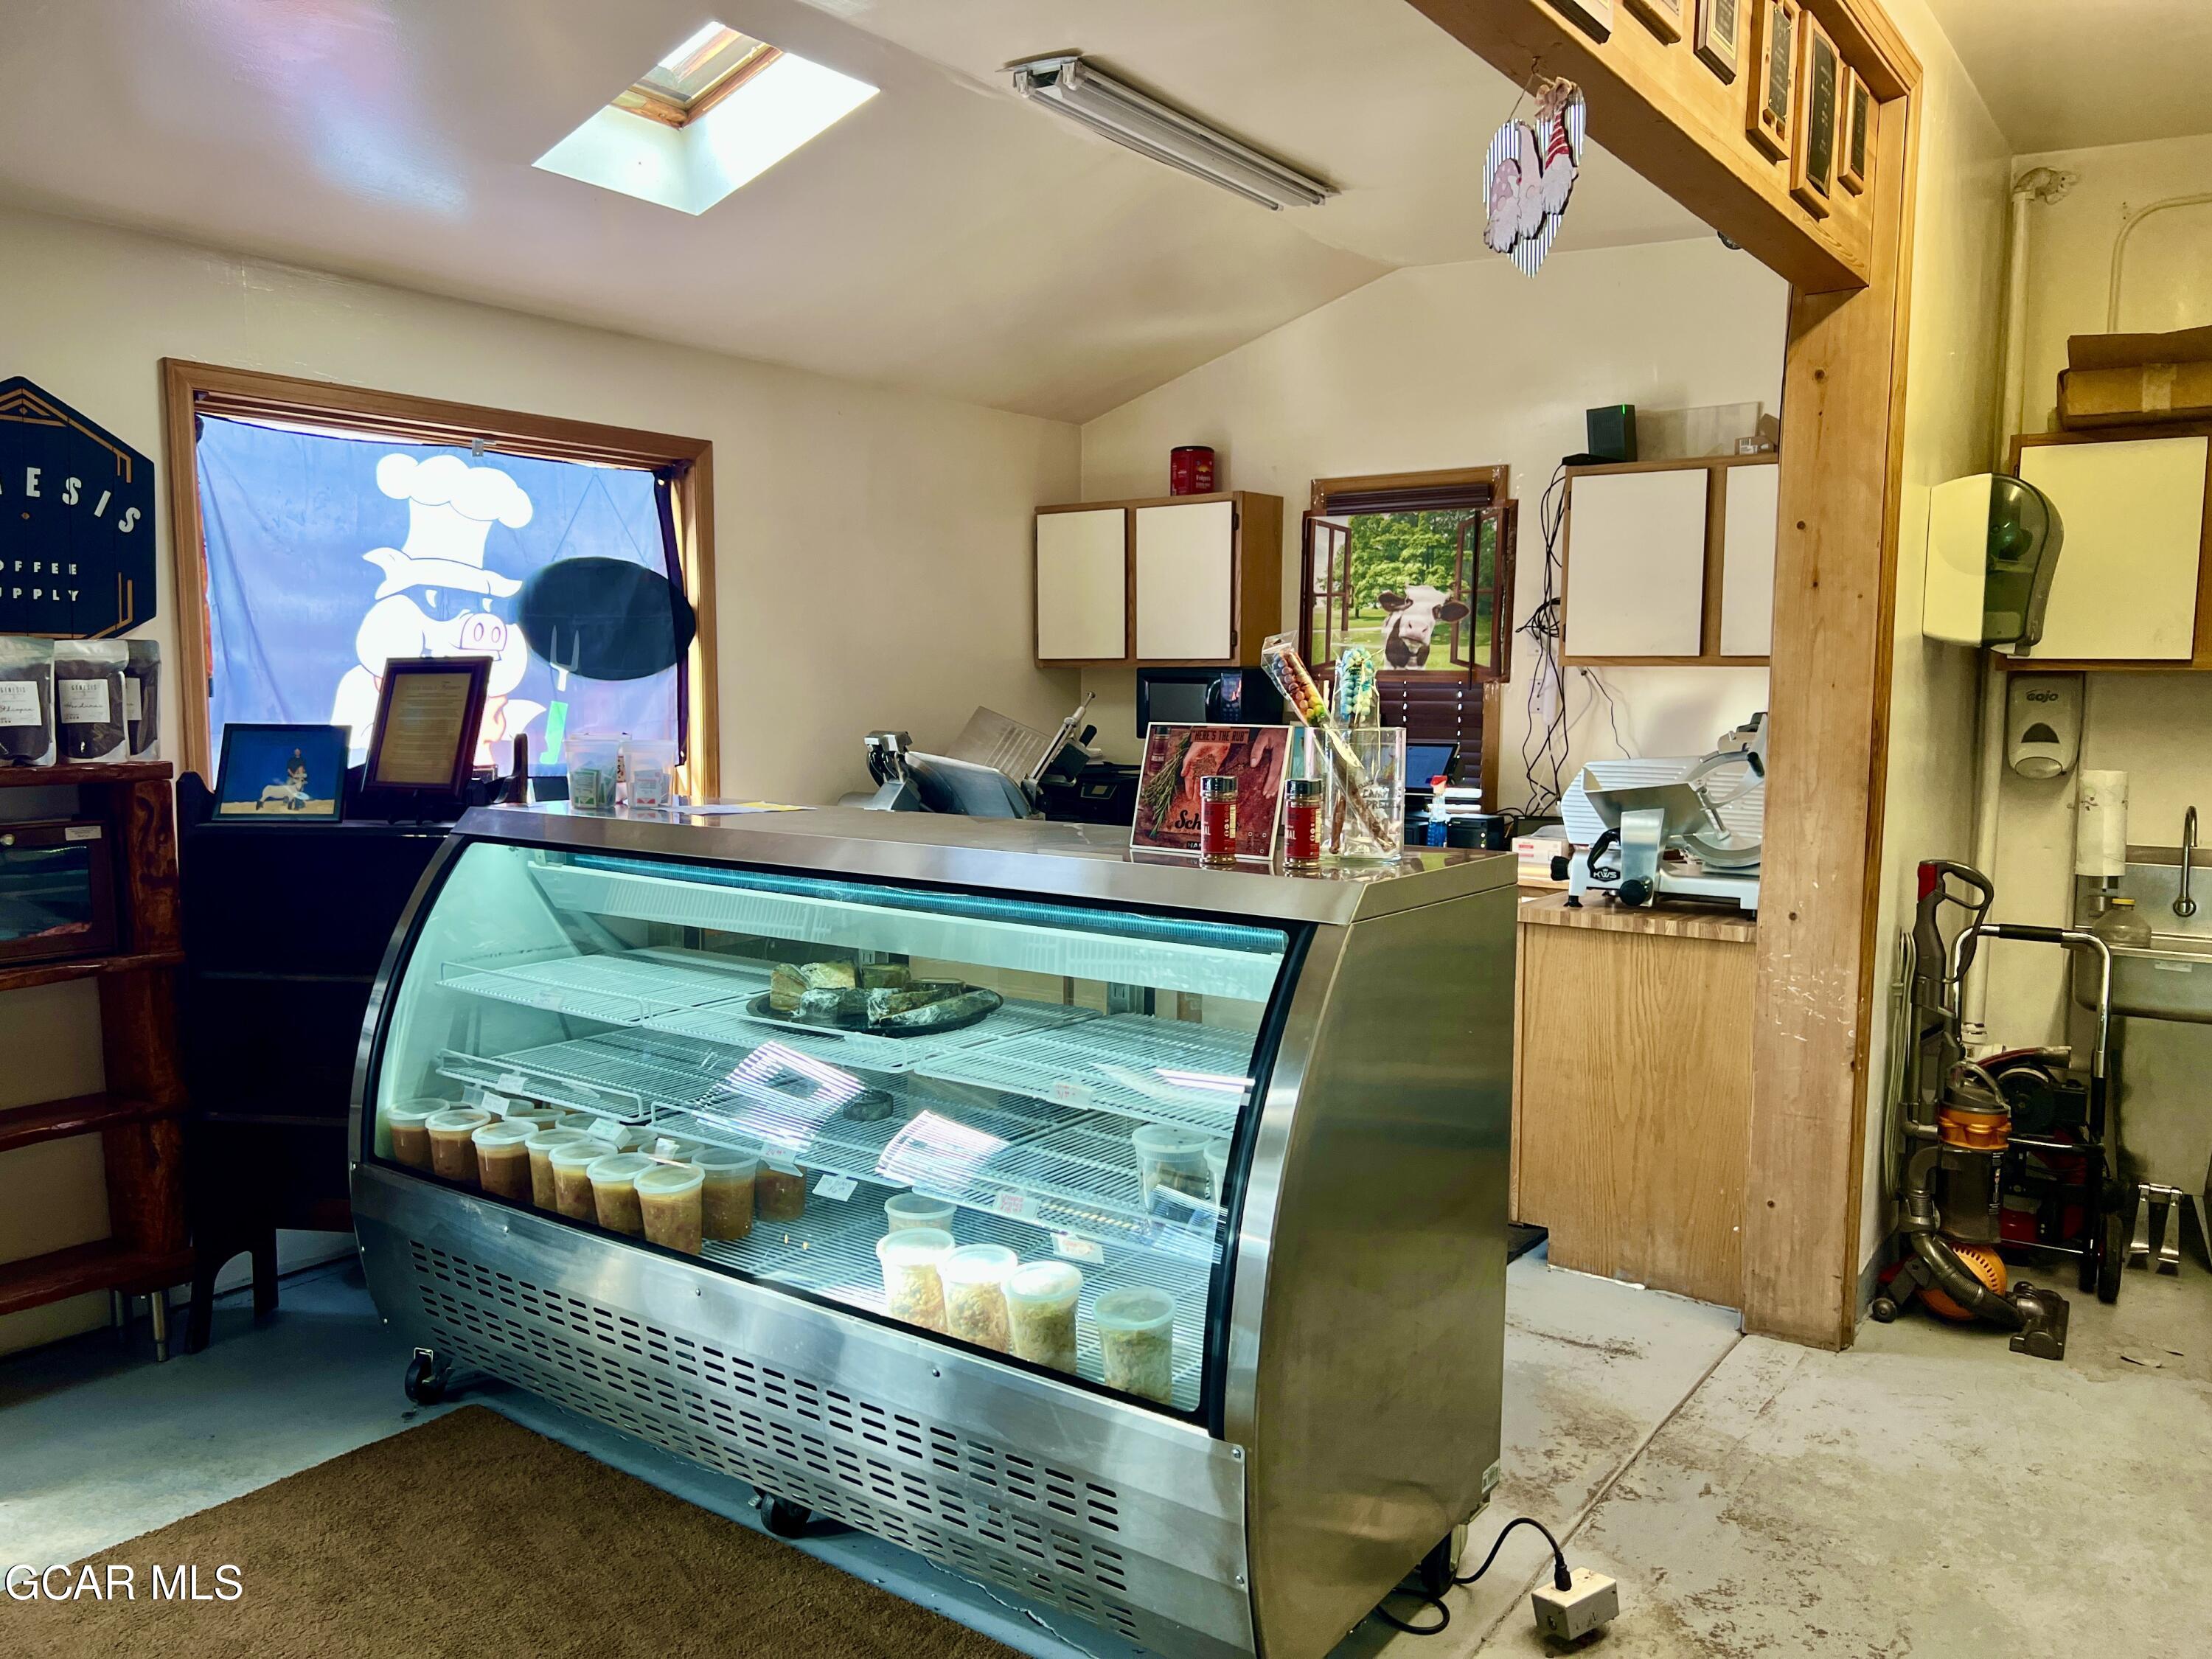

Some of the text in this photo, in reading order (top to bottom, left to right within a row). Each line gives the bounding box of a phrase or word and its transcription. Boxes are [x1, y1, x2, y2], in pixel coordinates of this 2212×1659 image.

[0, 467, 141, 533] ESIS
[0, 587, 79, 601] PPLY
[1219, 730, 1231, 741] THE
[1593, 871, 1617, 879] KWS
